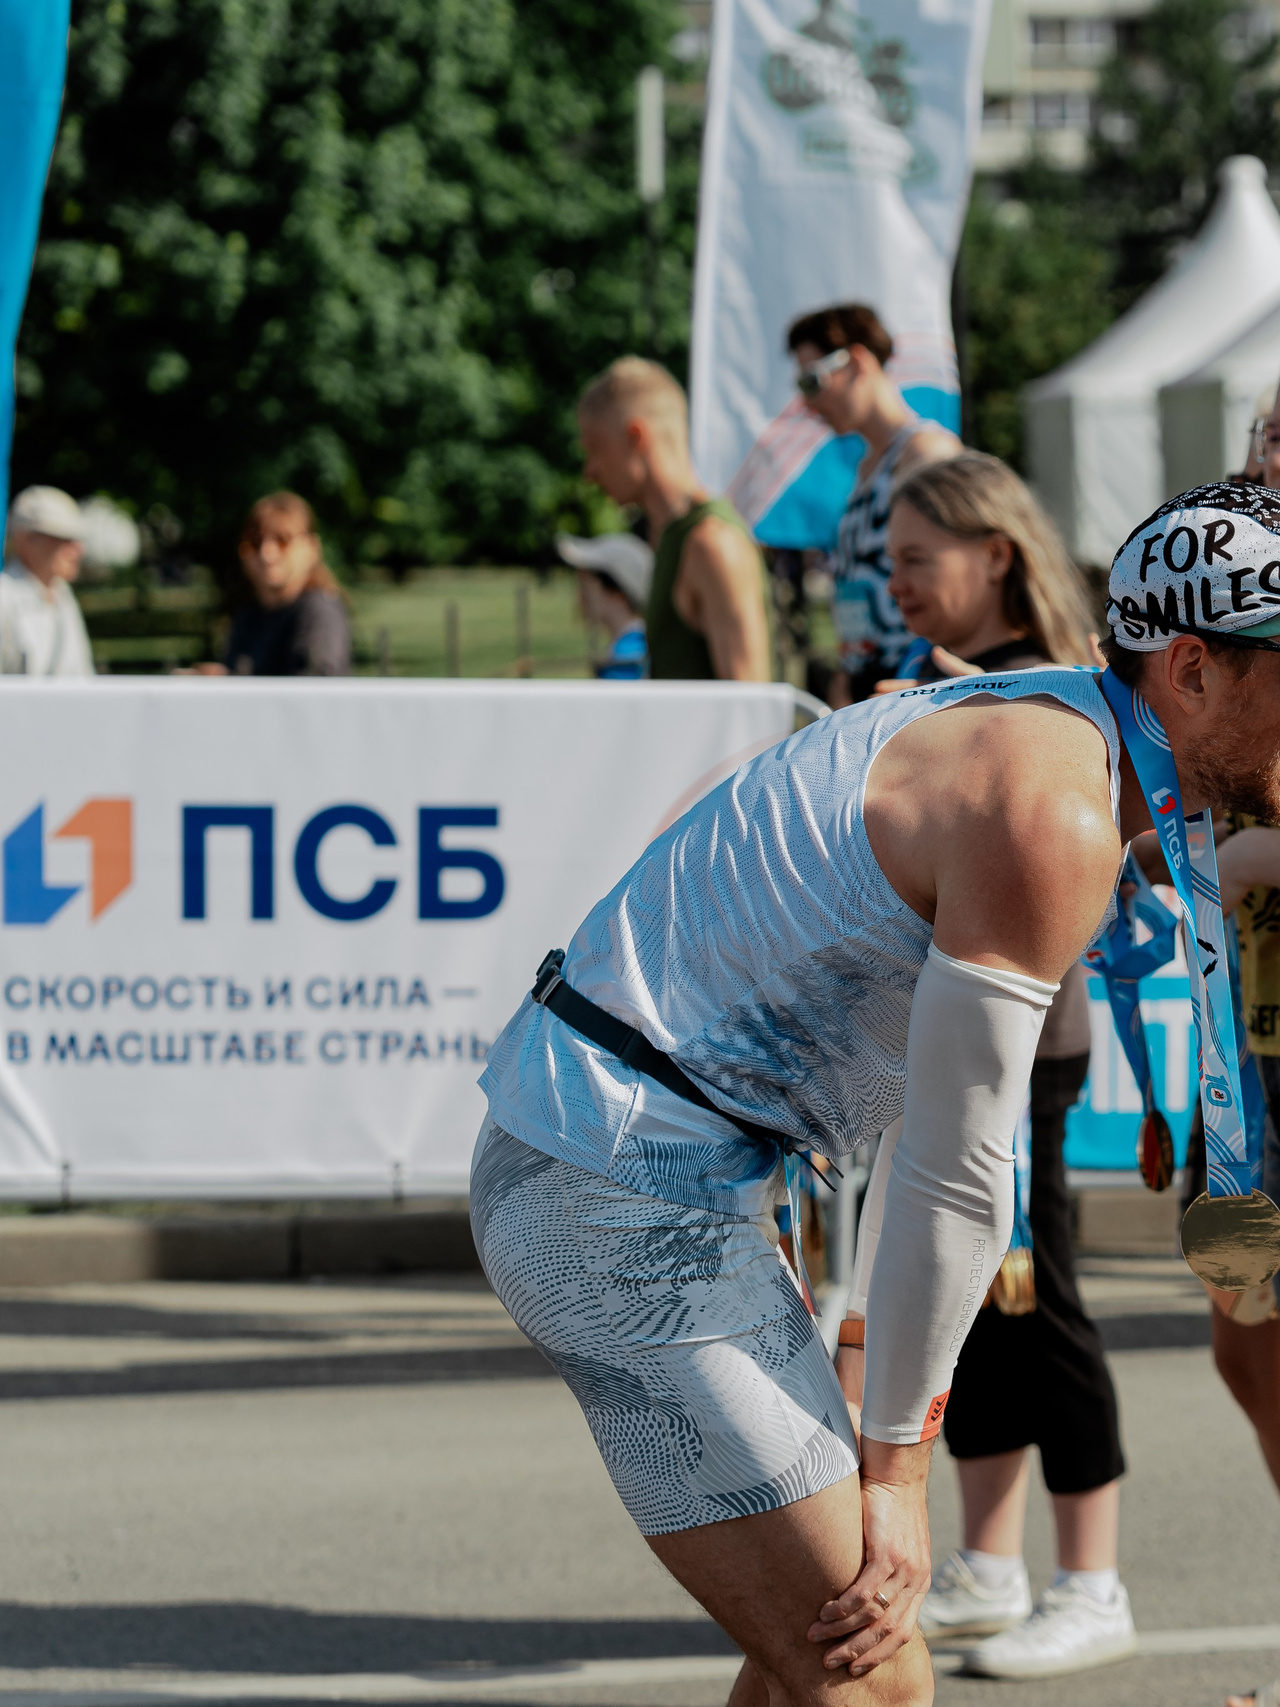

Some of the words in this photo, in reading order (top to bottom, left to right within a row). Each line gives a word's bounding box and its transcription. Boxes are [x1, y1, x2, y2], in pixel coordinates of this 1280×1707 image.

[1140, 518, 1236, 583] FOR
[900, 680, 1020, 698] ADIZERO
[1163, 817, 1185, 870] ПСБ
[182, 804, 506, 921] ПСБ
[3, 975, 251, 1010] СКОРОСТЬ
[265, 979, 293, 1009] И
[304, 975, 432, 1010] СИЛА
[7, 1031, 31, 1063] В
[46, 1031, 306, 1064] МАСШТАБЕ
[1205, 1074, 1233, 1109] 10
